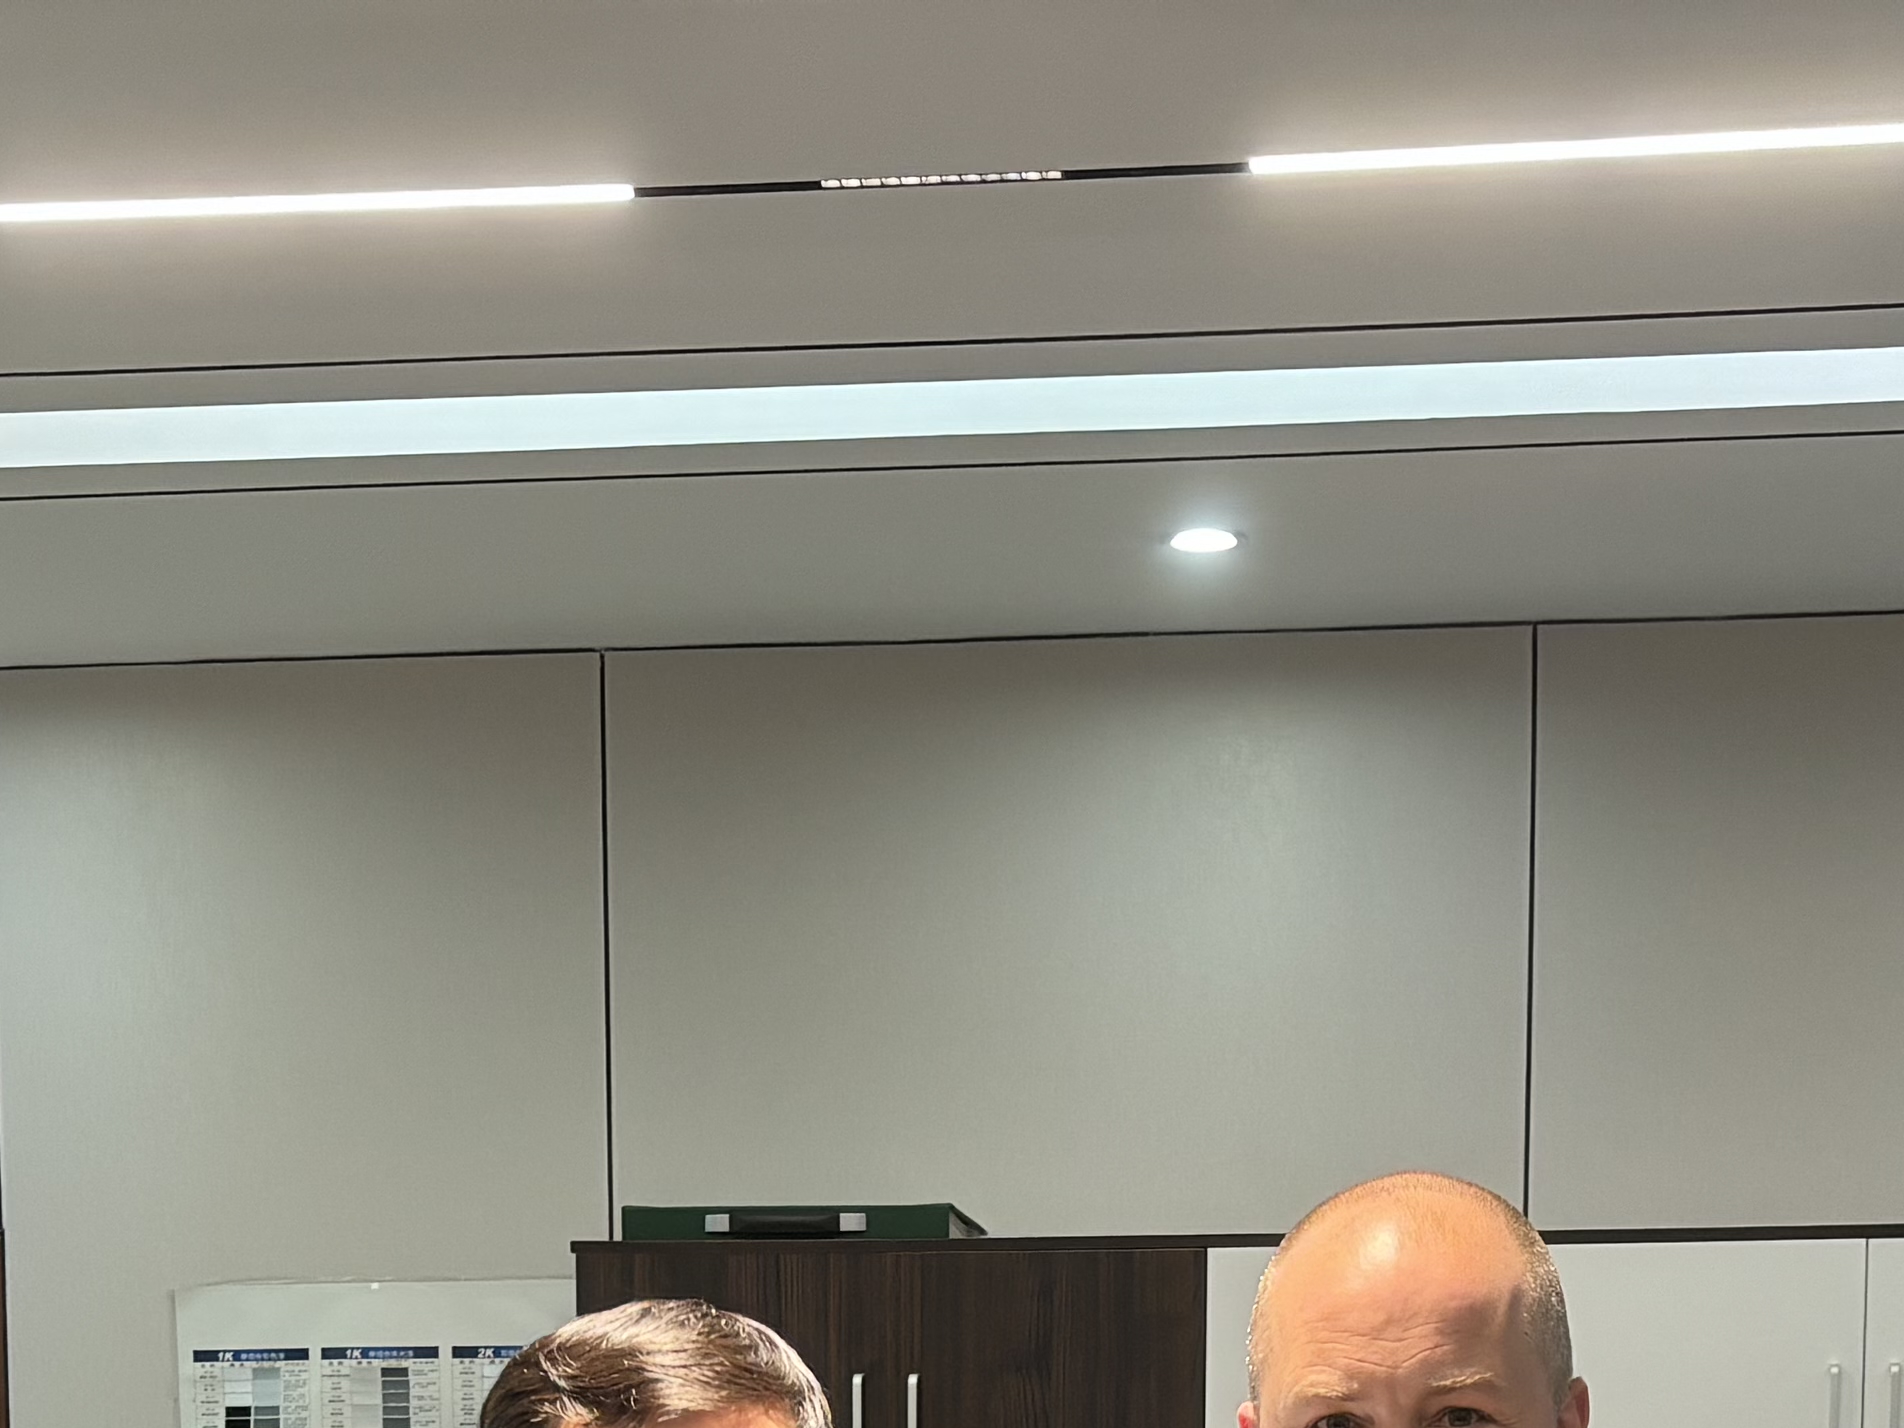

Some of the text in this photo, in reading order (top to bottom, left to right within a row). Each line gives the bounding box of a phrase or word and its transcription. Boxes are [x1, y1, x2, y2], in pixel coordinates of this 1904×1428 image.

[217, 1351, 234, 1361] 1K
[345, 1348, 362, 1359] 1K
[477, 1347, 495, 1359] 2K
